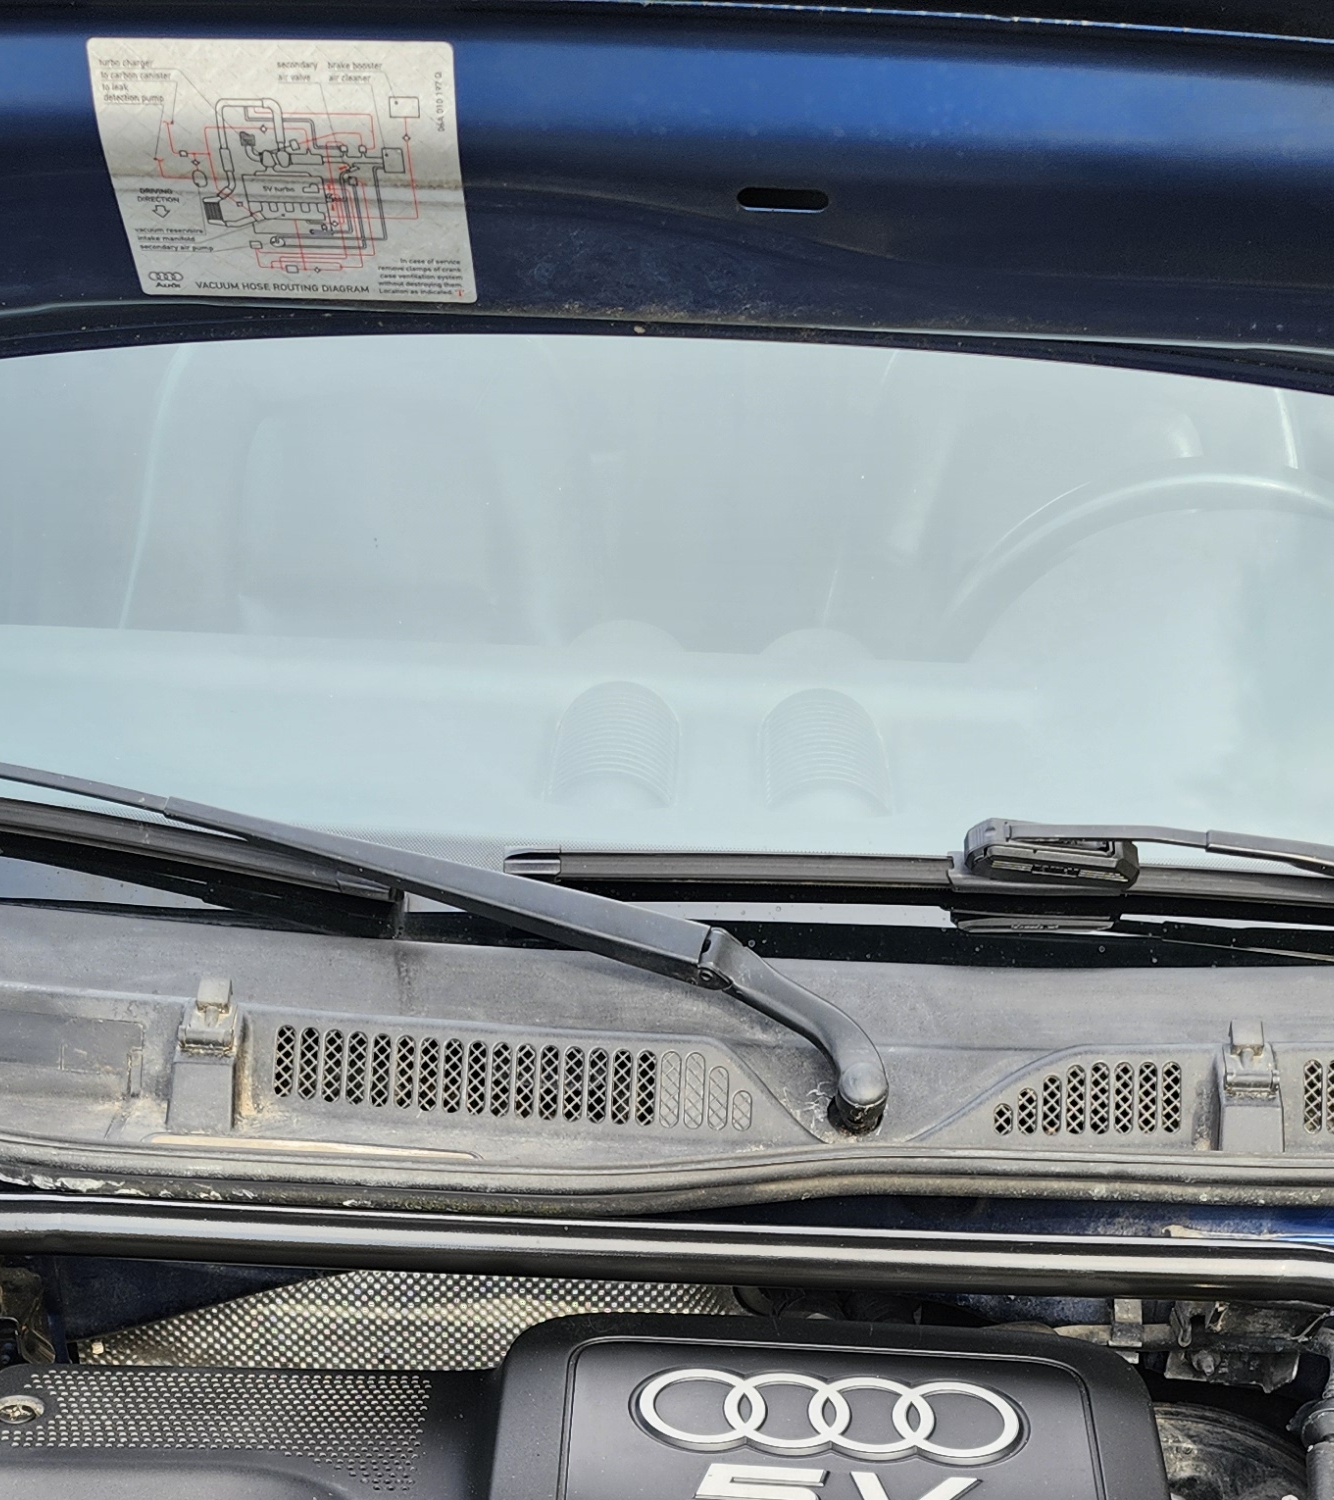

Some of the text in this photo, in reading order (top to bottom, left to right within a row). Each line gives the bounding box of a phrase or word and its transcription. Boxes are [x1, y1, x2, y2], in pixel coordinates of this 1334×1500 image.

[122, 59, 154, 69] charger
[277, 61, 318, 71] secondary
[328, 62, 382, 70] brake booster
[110, 72, 138, 80] carbon
[140, 72, 171, 80] canister
[341, 74, 371, 82] cleaner
[104, 94, 164, 104] detection pump
[436, 99, 444, 114] 010
[139, 187, 173, 195] DRIVING
[137, 196, 179, 204] DIRECTION
[195, 281, 370, 293] VACUUM HOSE ROUTING DIAGRAM
